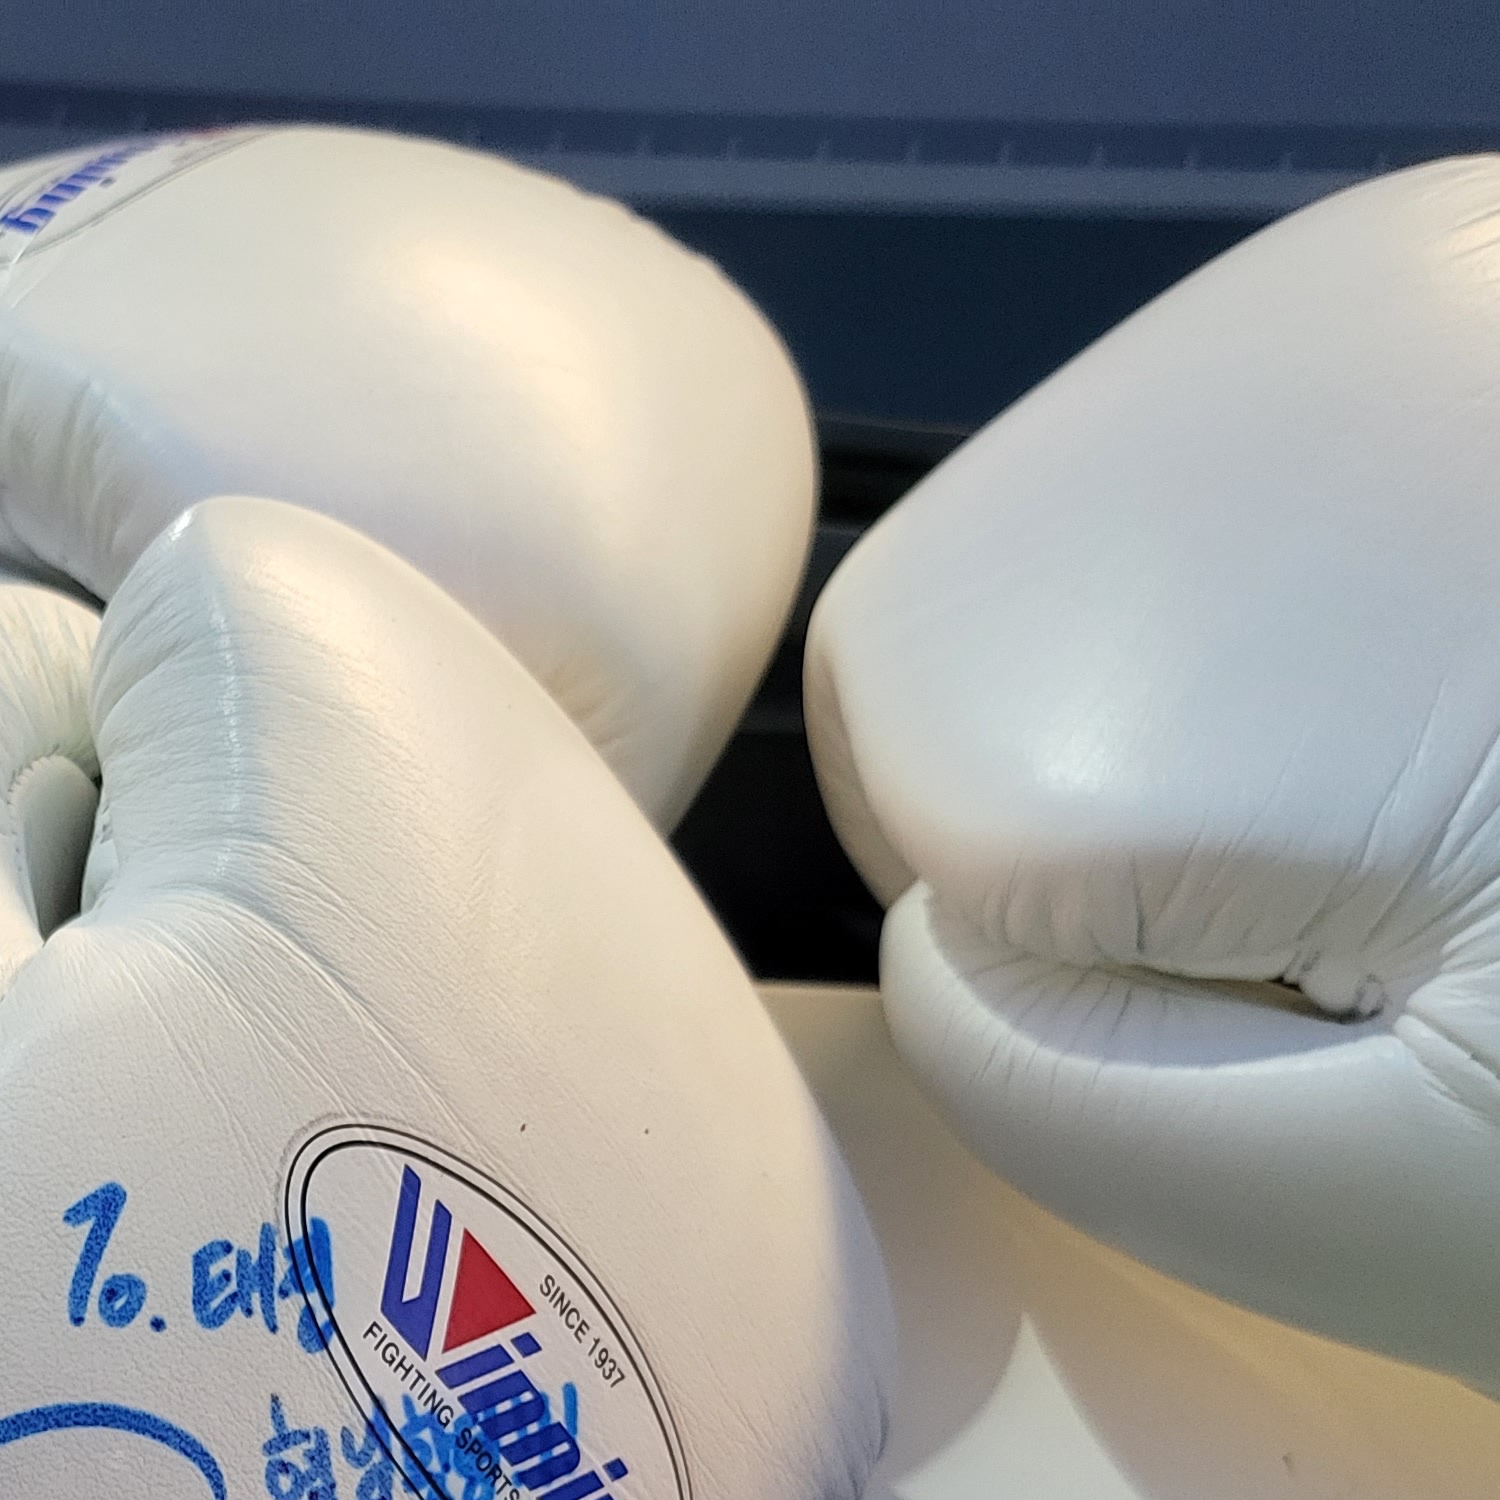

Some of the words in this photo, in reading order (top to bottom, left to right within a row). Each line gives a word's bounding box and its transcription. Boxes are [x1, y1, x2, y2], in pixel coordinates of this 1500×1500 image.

[362, 1320, 455, 1430] FIGHTING
[538, 1274, 589, 1342] SINCE
[591, 1335, 626, 1389] 1937
